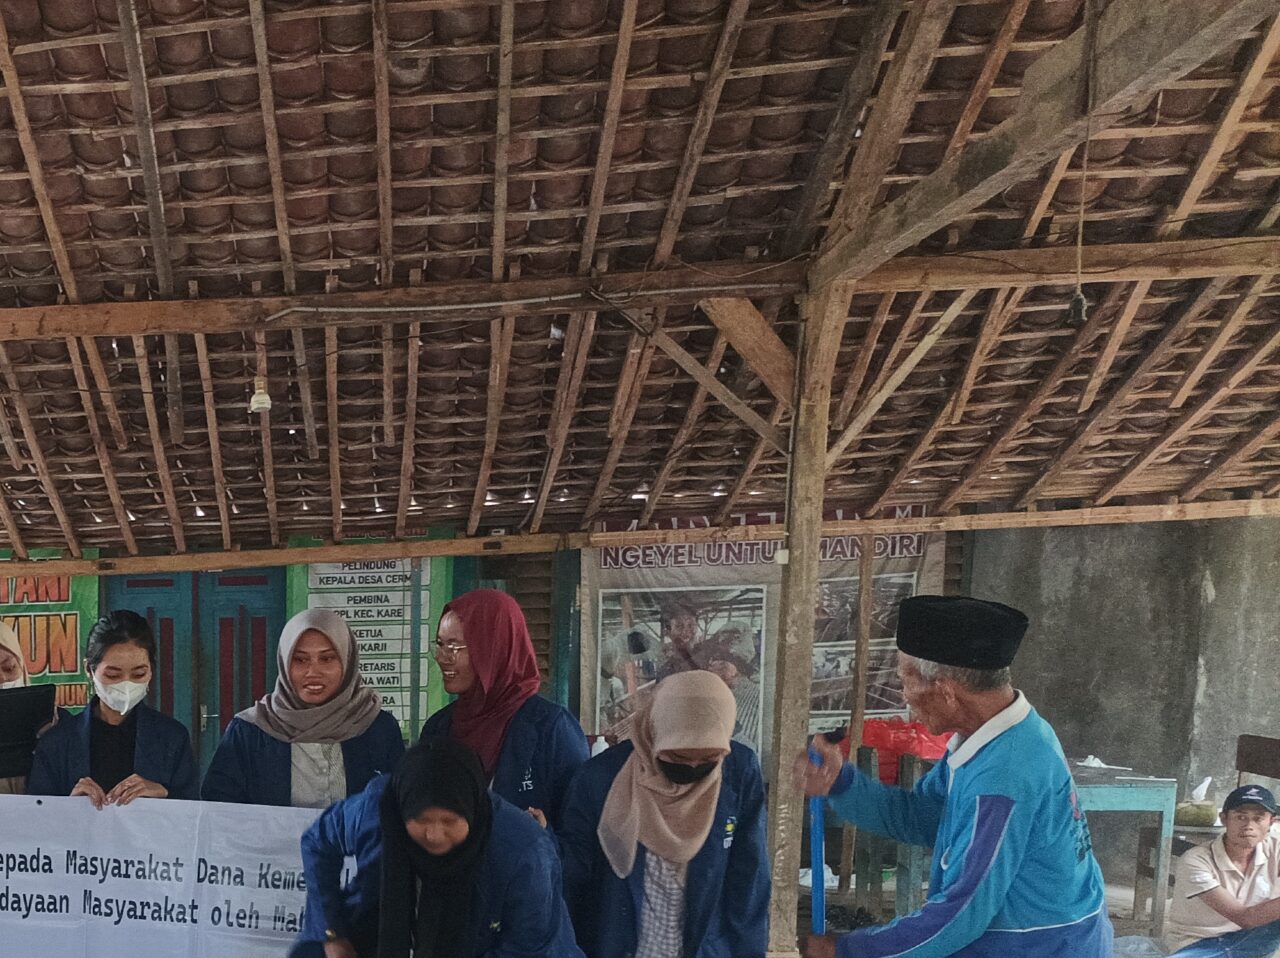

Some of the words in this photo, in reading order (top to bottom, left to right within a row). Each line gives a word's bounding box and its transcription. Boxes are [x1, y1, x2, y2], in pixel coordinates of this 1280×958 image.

[601, 541, 701, 570] NGEYEL
[704, 540, 786, 566] UNTU
[342, 559, 396, 570] PELINDUNG
[319, 576, 356, 585] KEPALA
[358, 575, 382, 584] DESA
[385, 574, 412, 583] CERM
[347, 595, 389, 604] PEMBINA
[353, 609, 374, 618] KEC.
[377, 608, 403, 617] KARE
[352, 628, 383, 638] KETUA
[357, 662, 396, 671] RETARIS
[377, 675, 399, 685] WATI
[65, 850, 184, 887] Masyarakat
[196, 857, 246, 889] Dana
[83, 889, 198, 927] Masyarakat
[210, 900, 260, 930] oleh
